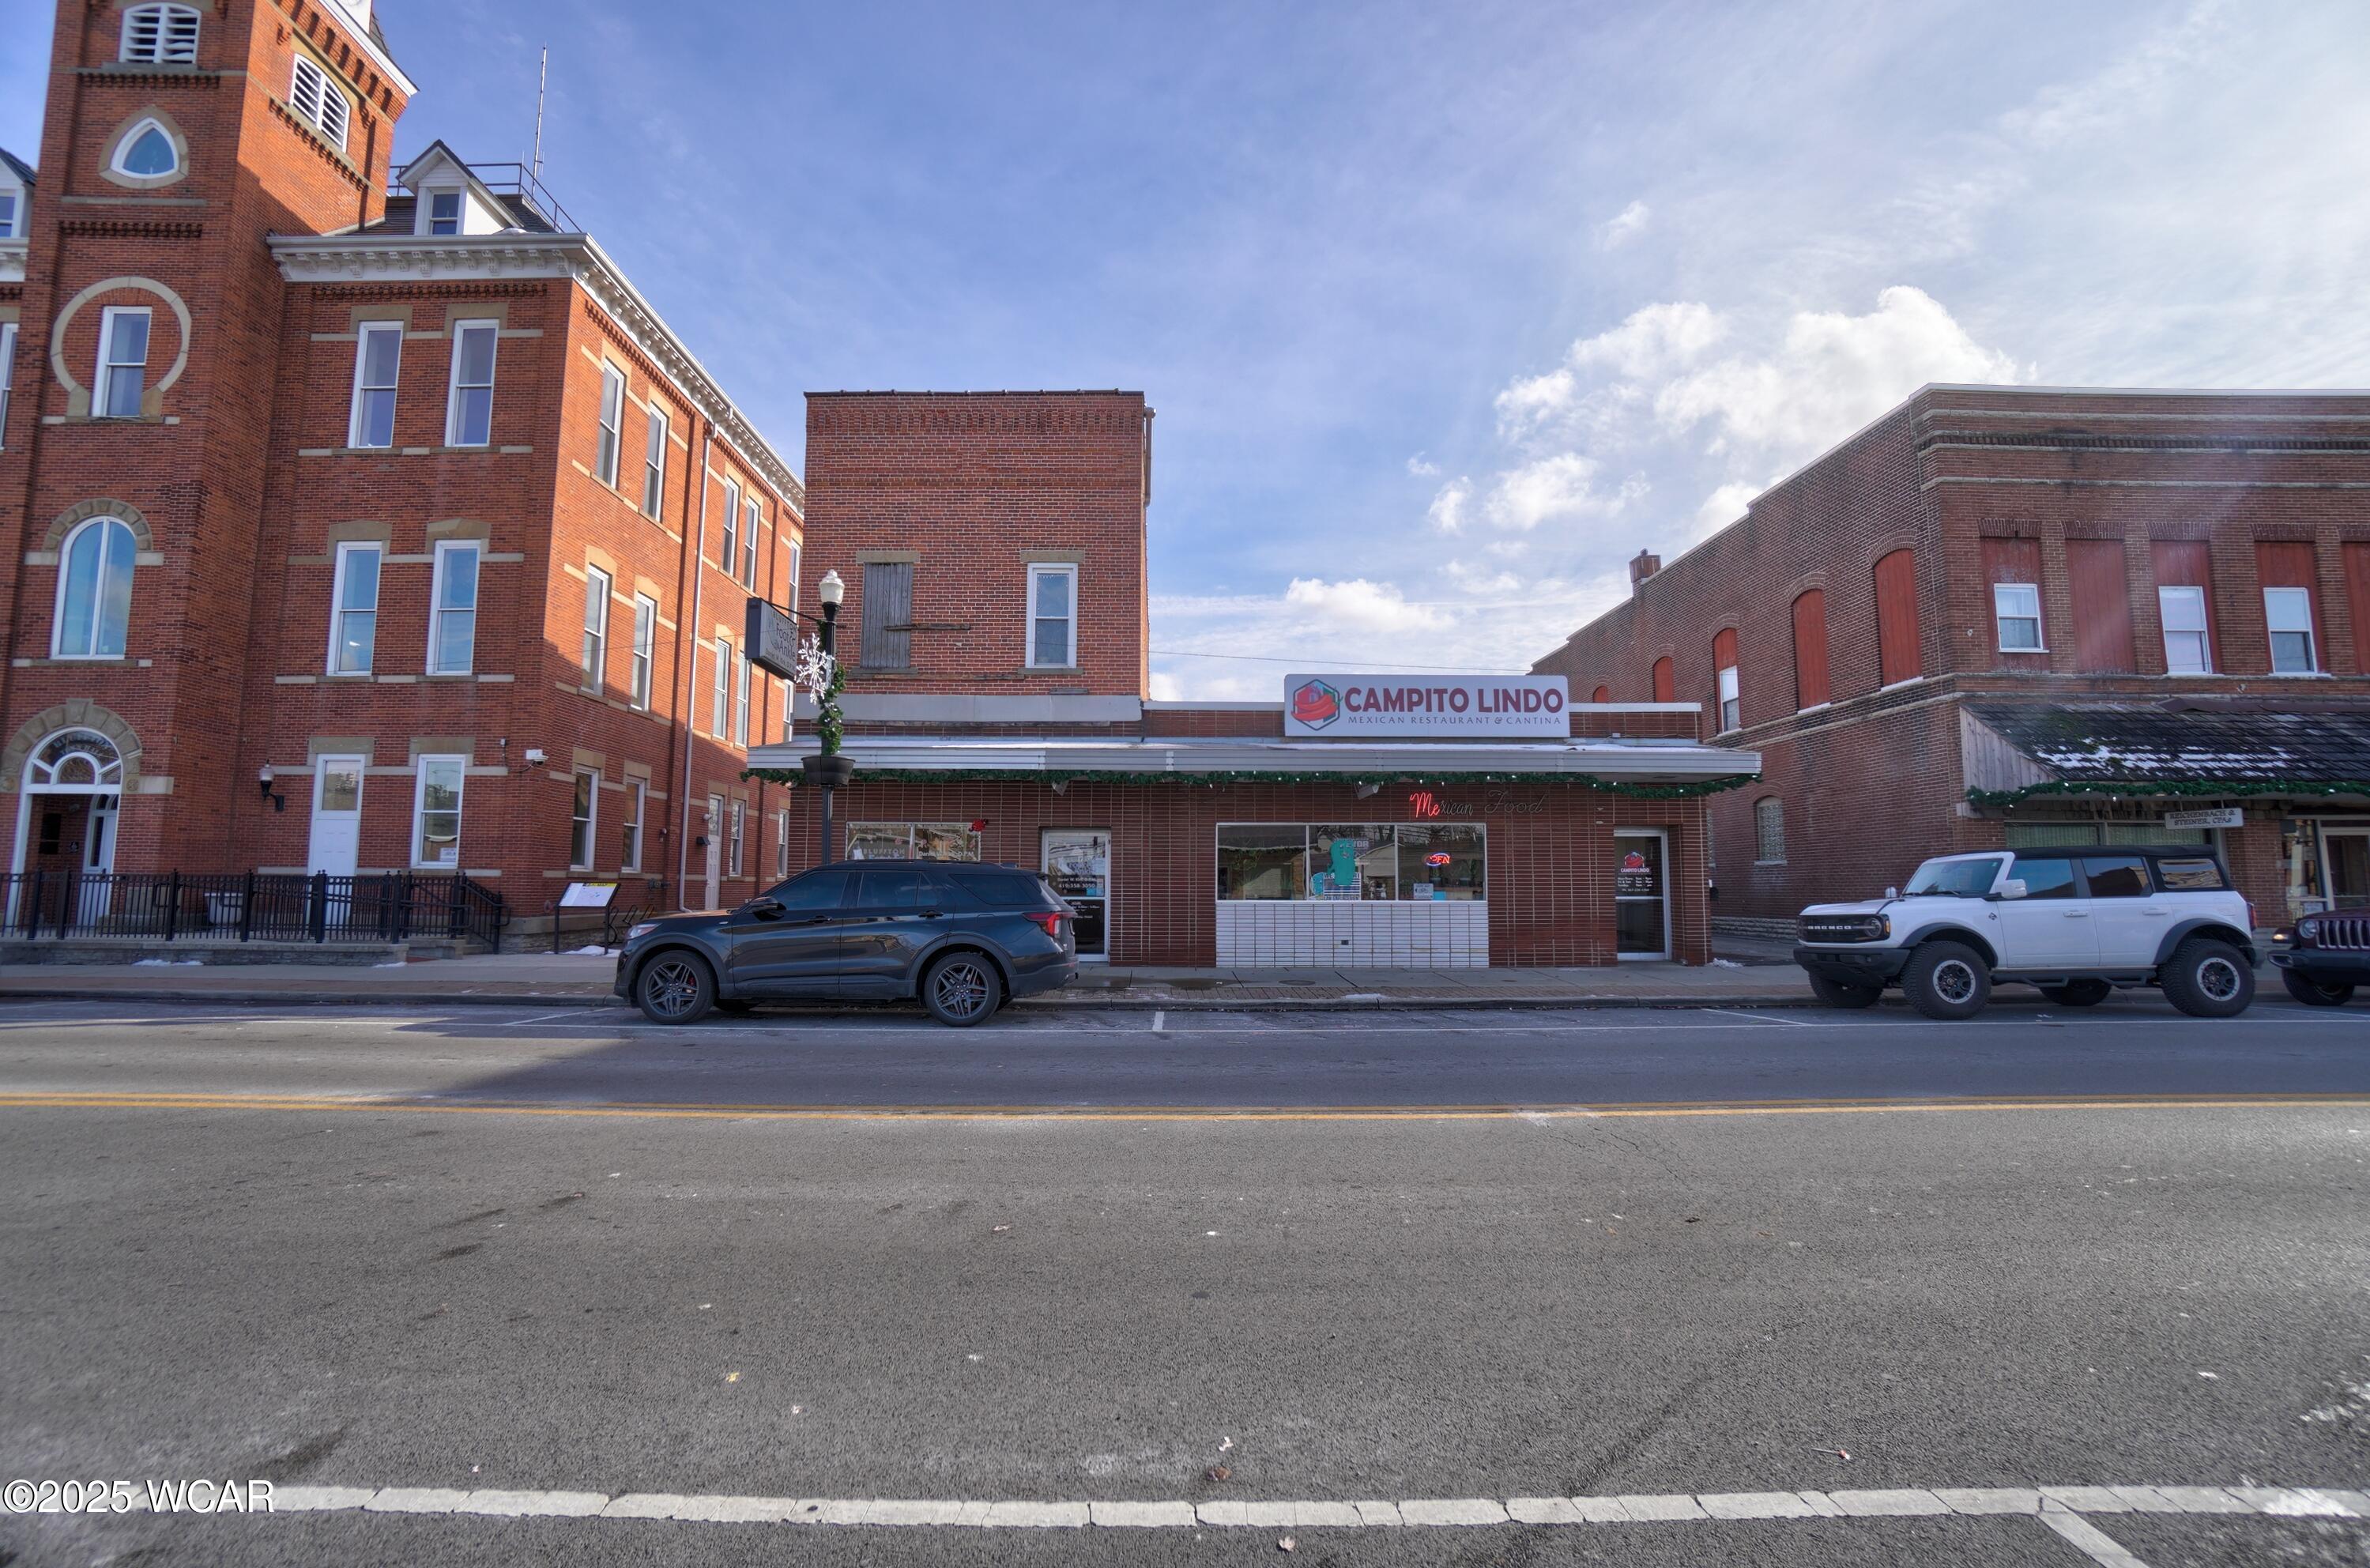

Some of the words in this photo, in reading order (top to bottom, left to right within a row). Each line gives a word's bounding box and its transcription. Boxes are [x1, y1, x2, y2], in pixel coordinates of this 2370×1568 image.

[777, 622, 789, 644] Foot
[778, 640, 796, 662] Ankle
[1344, 687, 1470, 713] CAMPITO
[1477, 688, 1564, 714] LINDO
[1411, 716, 1490, 725] RESTAURANT
[1494, 716, 1503, 725] &
[1505, 716, 1561, 725] CANTINA
[1410, 791, 1473, 818] Mexican
[1484, 790, 1547, 813] Food
[2169, 810, 2226, 820] REICHENBACH
